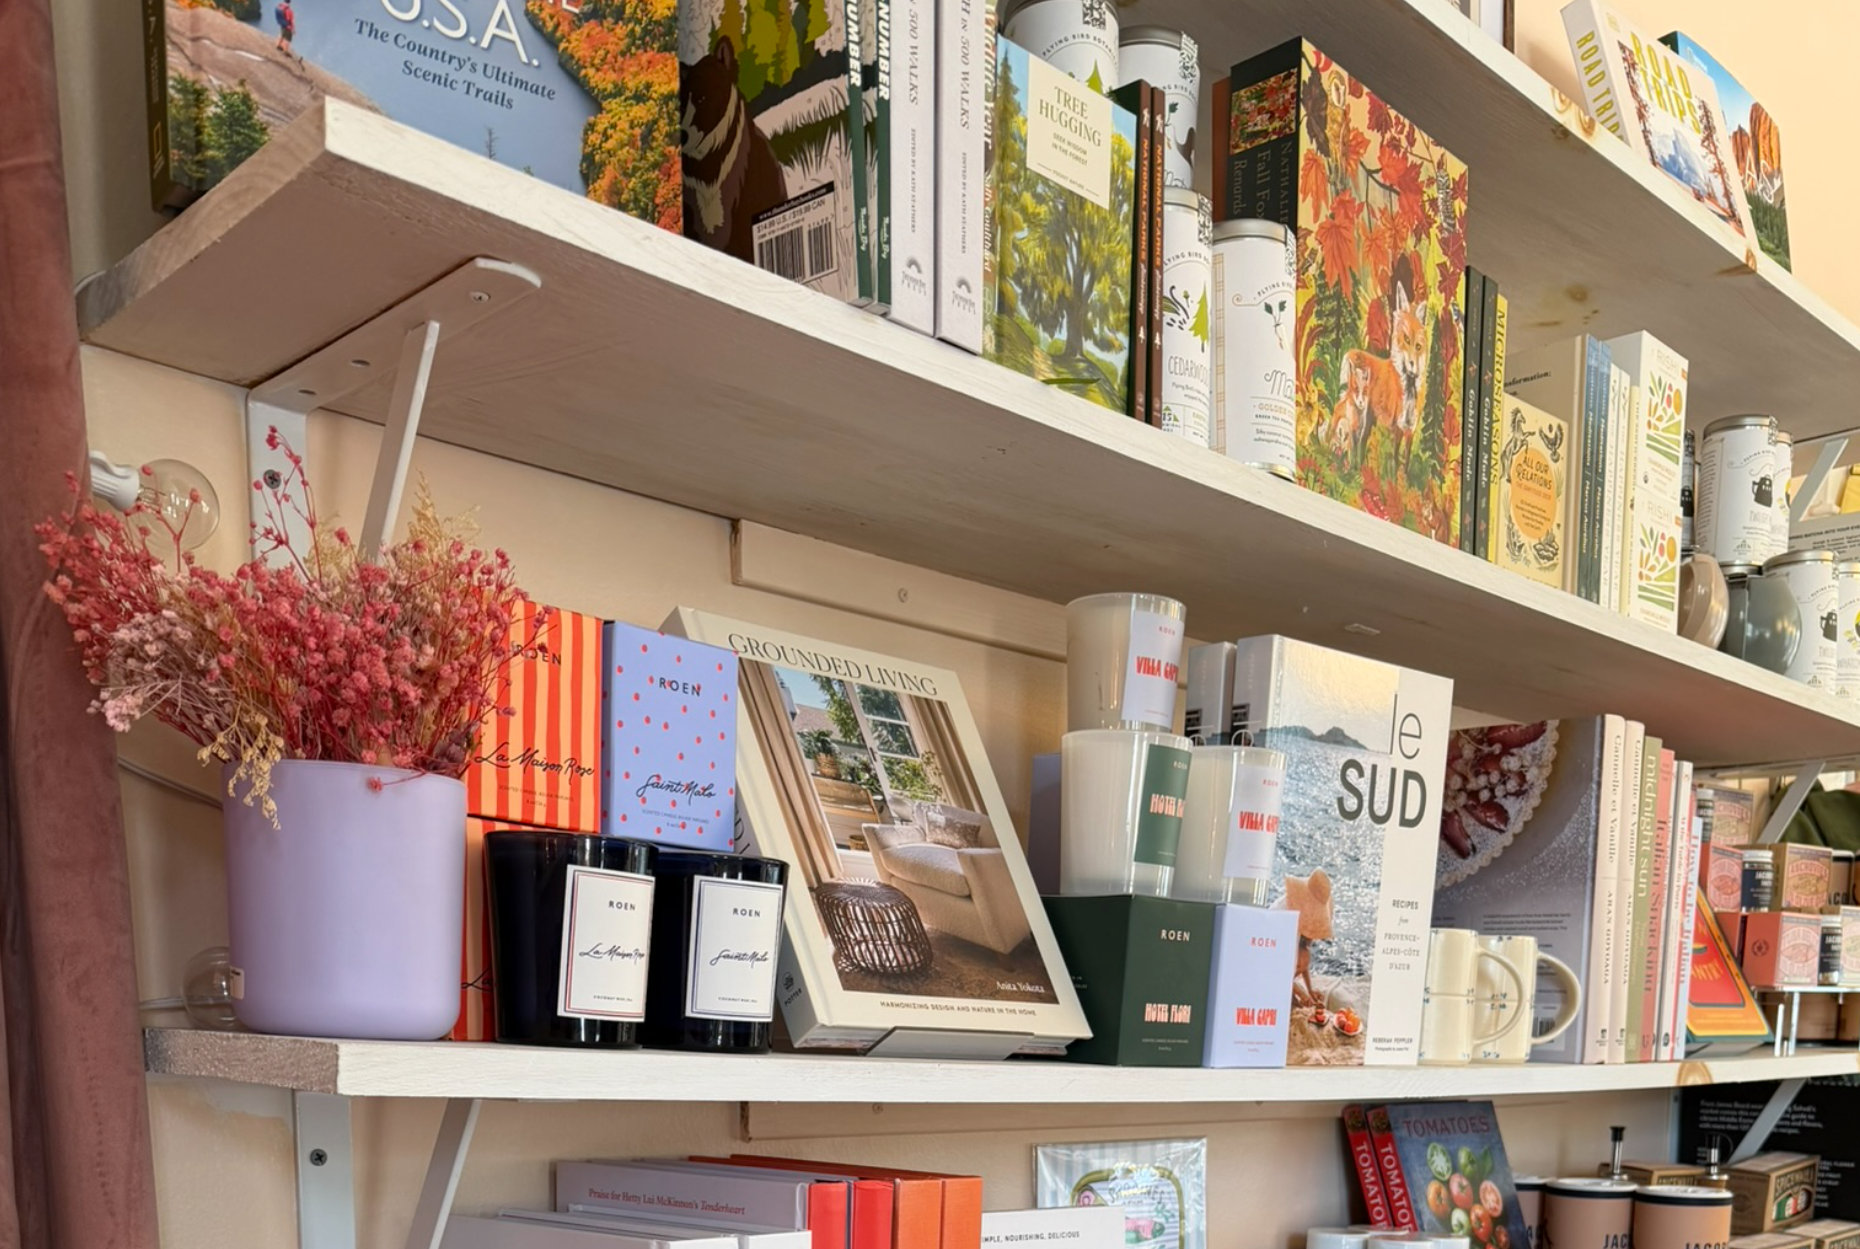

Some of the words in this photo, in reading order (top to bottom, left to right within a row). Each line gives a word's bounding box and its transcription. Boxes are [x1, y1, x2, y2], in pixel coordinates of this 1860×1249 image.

[846, 0, 861, 87] UMBER
[908, 9, 919, 38] 500
[354, 18, 389, 43] The
[393, 33, 478, 73] Country's
[482, 62, 556, 101] Ultimate
[908, 44, 919, 105] WALKS
[1576, 30, 1608, 88] ROAD
[1630, 30, 1692, 100] ROAD
[402, 60, 457, 91] Scenic
[462, 80, 514, 110] Trails
[1054, 86, 1089, 120] TREE
[1639, 69, 1701, 135] TRIPS
[1039, 99, 1101, 147] HUGGING
[1233, 161, 1247, 214] Renards
[1467, 389, 1476, 440] Goblin
[1489, 309, 1507, 486] MICROSEASONS
[1481, 396, 1490, 449] Goblin
[1464, 443, 1474, 482] Mode
[1480, 450, 1489, 489] Mode
[1516, 463, 1552, 490] RELATIONS
[1523, 456, 1534, 470] ALL
[1535, 460, 1549, 474] OUR
[1647, 503, 1672, 518] RISHI
[658, 677, 702, 697] ROEN
[728, 633, 861, 679] GROUNDED
[864, 665, 938, 696] LIVING
[1389, 693, 1422, 760] le
[1612, 735, 1621, 796] Cannelle
[1336, 758, 1427, 828] SUD
[1640, 754, 1657, 850] midnight
[1609, 817, 1617, 864] Vanille
[1652, 819, 1667, 885] Italian
[1638, 857, 1648, 898] sun
[608, 900, 636, 911] ROEN
[732, 907, 762, 918] ROEN
[1392, 899, 1419, 910] RECIPES
[1161, 929, 1190, 942] ROEN
[1251, 937, 1277, 948] ROEN
[1383, 932, 1420, 943] PROVENCE-
[1644, 892, 1662, 991] Snacking
[996, 981, 1017, 991] Anita
[1018, 981, 1046, 994] Yokota
[1403, 1115, 1490, 1139] TOMATOES
[588, 1188, 610, 1200] Praise
[610, 1190, 621, 1201] for
[622, 1191, 642, 1205] Hetty
[643, 1193, 655, 1205] Lui
[656, 1195, 699, 1210] McKinnon's
[700, 1201, 746, 1216] Tenderheart
[1005, 1232, 1047, 1242] NOURISHING,
[1048, 1231, 1080, 1240] DELICIOUS
